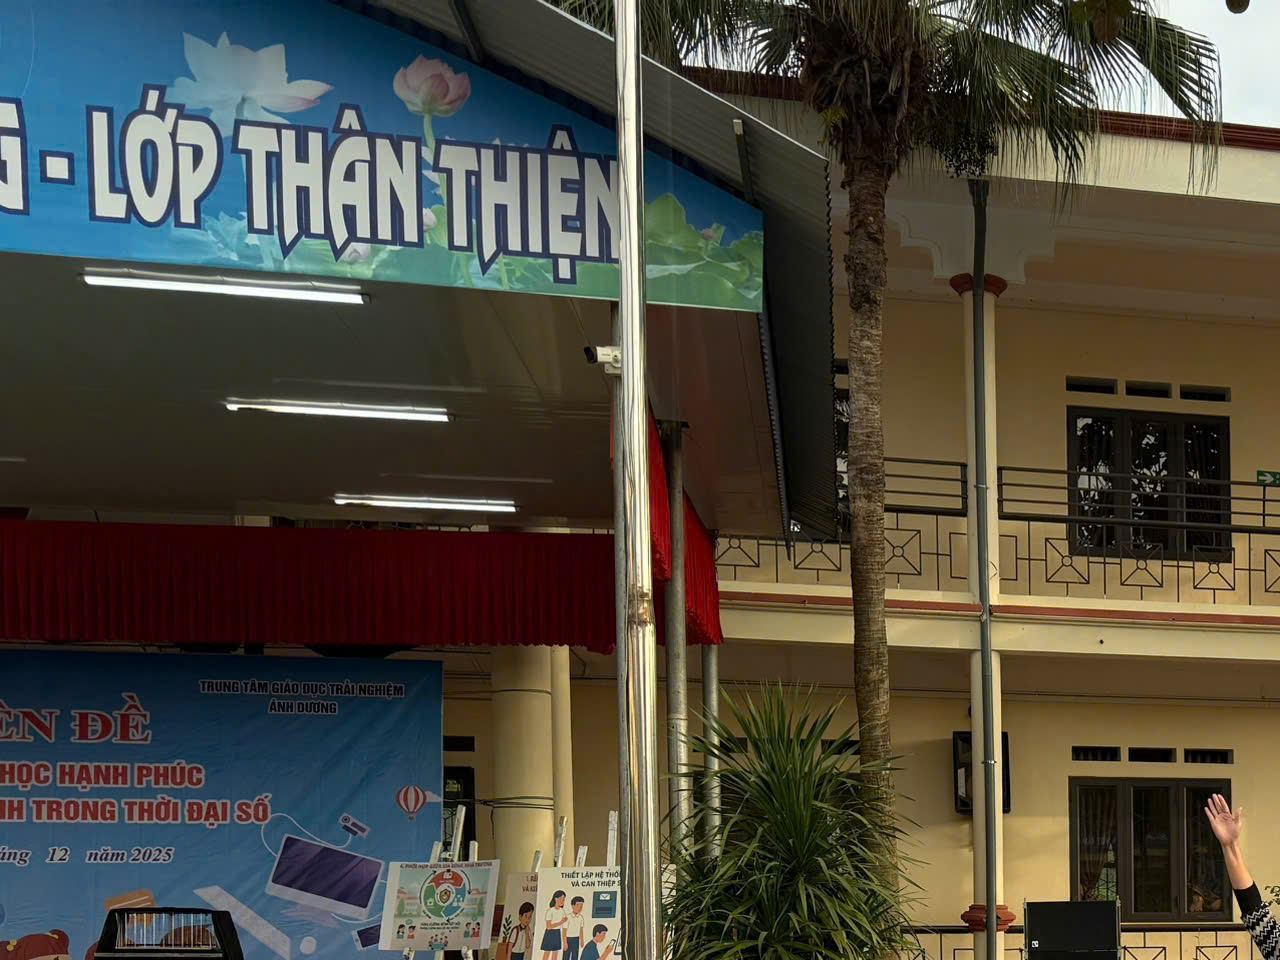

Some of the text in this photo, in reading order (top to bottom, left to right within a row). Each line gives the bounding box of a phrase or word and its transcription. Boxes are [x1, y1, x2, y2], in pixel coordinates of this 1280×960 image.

[88, 85, 222, 227] LỚP
[234, 107, 424, 259] THÂN
[435, 126, 619, 284] THIỆN
[200, 678, 405, 699] TRUNG TÂM GIÁO DỤC TRẢI NGHIỆM
[72, 693, 151, 743] ĐỀ
[296, 700, 338, 715] DƯƠNG
[0, 760, 205, 791] HỌC HẠNH PHÚC
[30, 798, 118, 822] TRONG
[122, 795, 181, 823] THỜI
[185, 798, 229, 828] ĐẠI
[234, 793, 272, 824] SỐ
[46, 846, 69, 863] 12
[86, 846, 126, 863] năm
[129, 846, 175, 864] 2025
[561, 870, 619, 880] THIẾT LẬP HỆ THỐ
[597, 879, 616, 888] THIỆP
